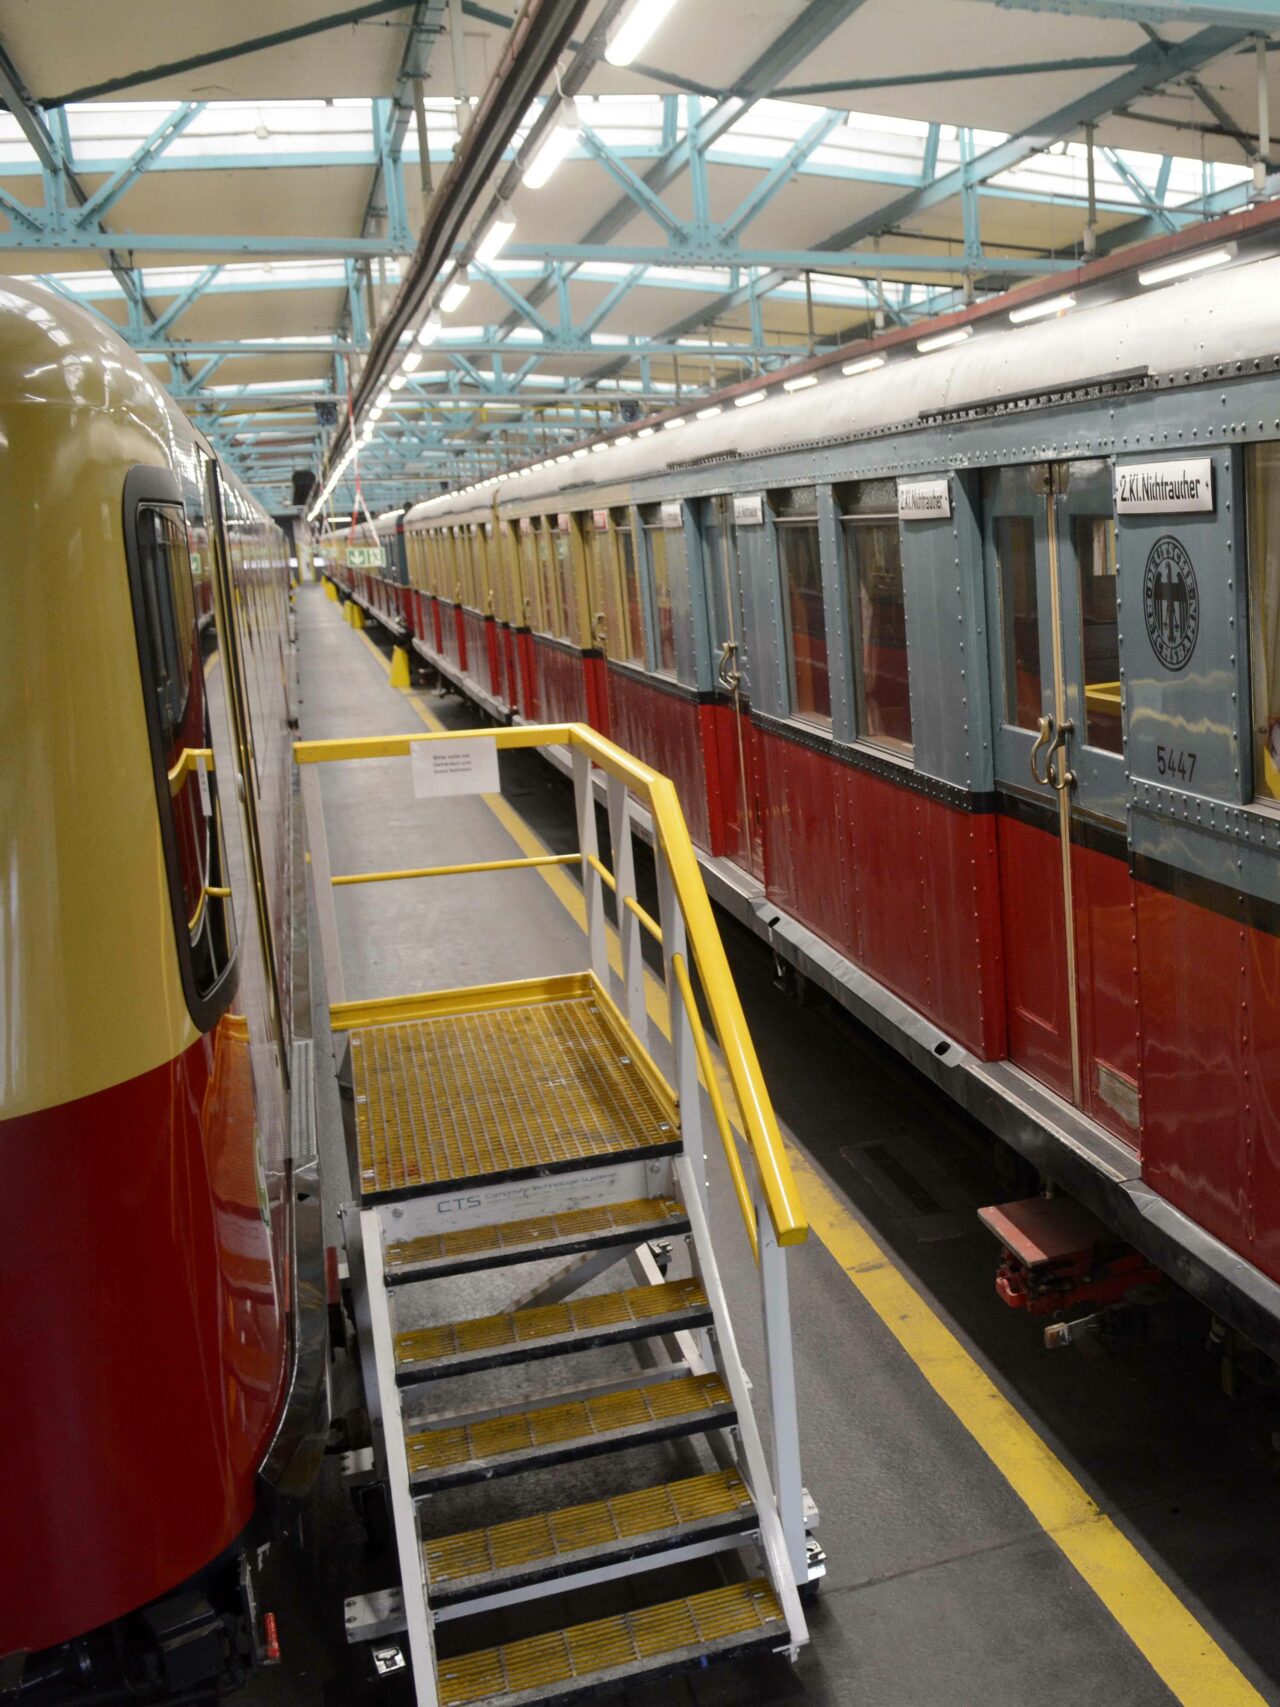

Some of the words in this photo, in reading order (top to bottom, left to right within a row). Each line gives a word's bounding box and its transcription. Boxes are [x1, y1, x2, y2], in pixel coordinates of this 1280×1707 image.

[1147, 542, 1195, 590] DEUTSCHE
[1157, 745, 1197, 782] 5447
[437, 1197, 481, 1213] CTS
